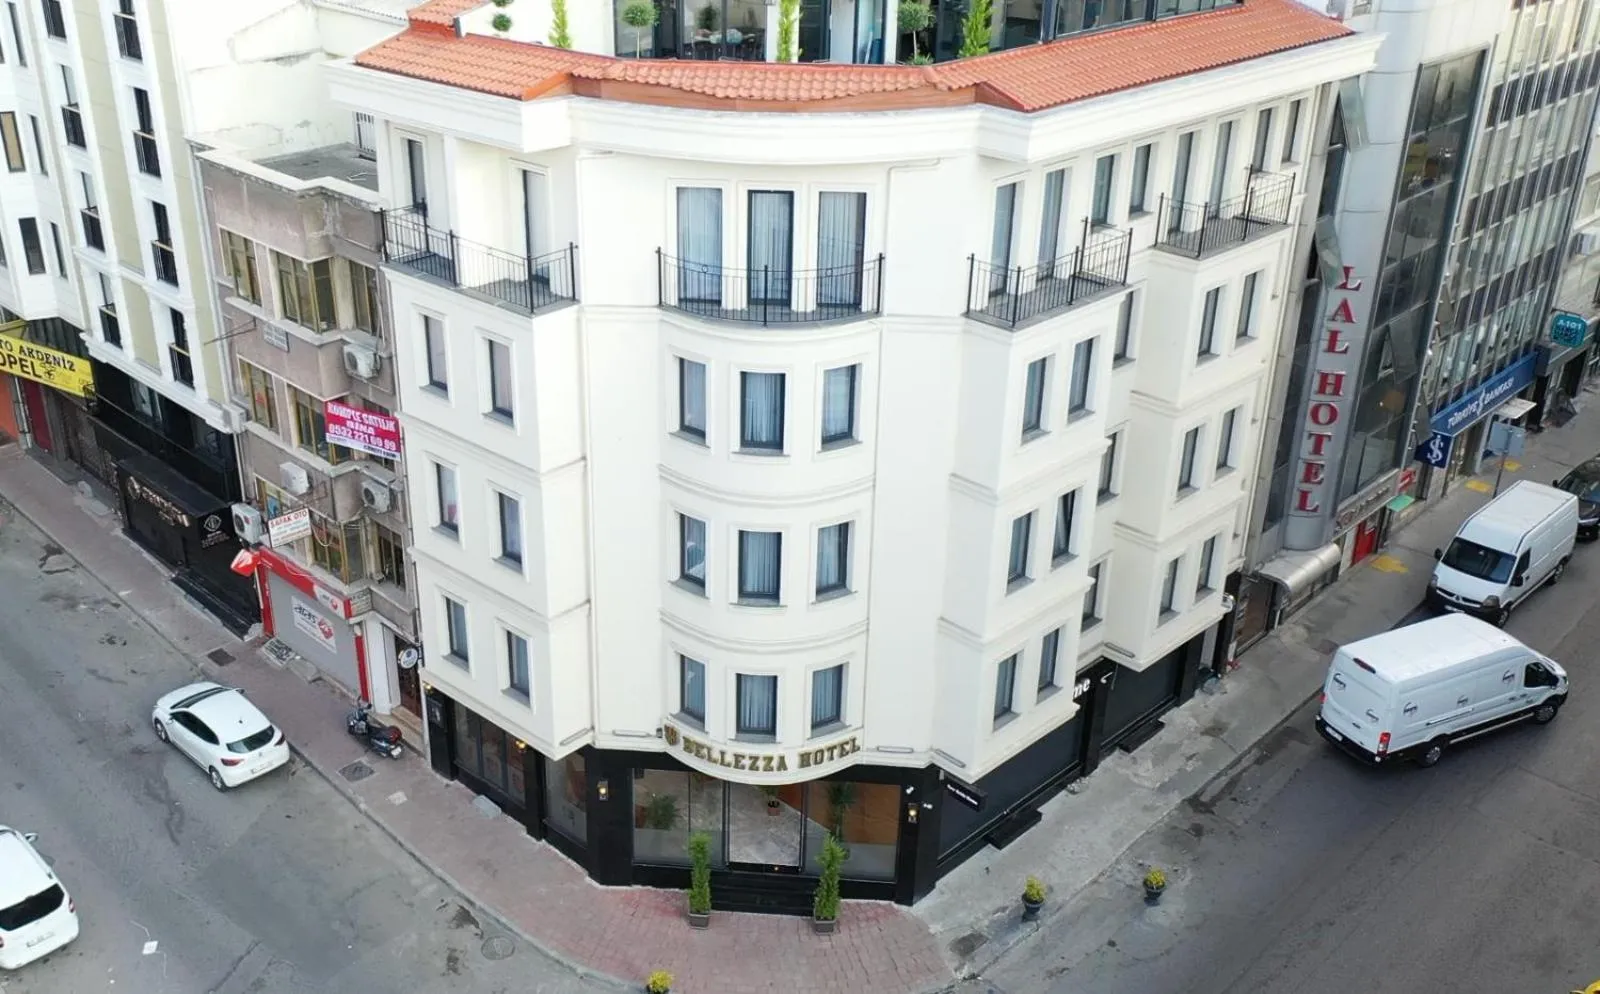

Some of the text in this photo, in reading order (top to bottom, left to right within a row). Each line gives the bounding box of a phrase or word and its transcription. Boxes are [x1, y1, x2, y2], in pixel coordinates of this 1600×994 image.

[1296, 370, 1347, 513] HOTEL
[682, 735, 861, 772] BELLEZZA HOTEL
